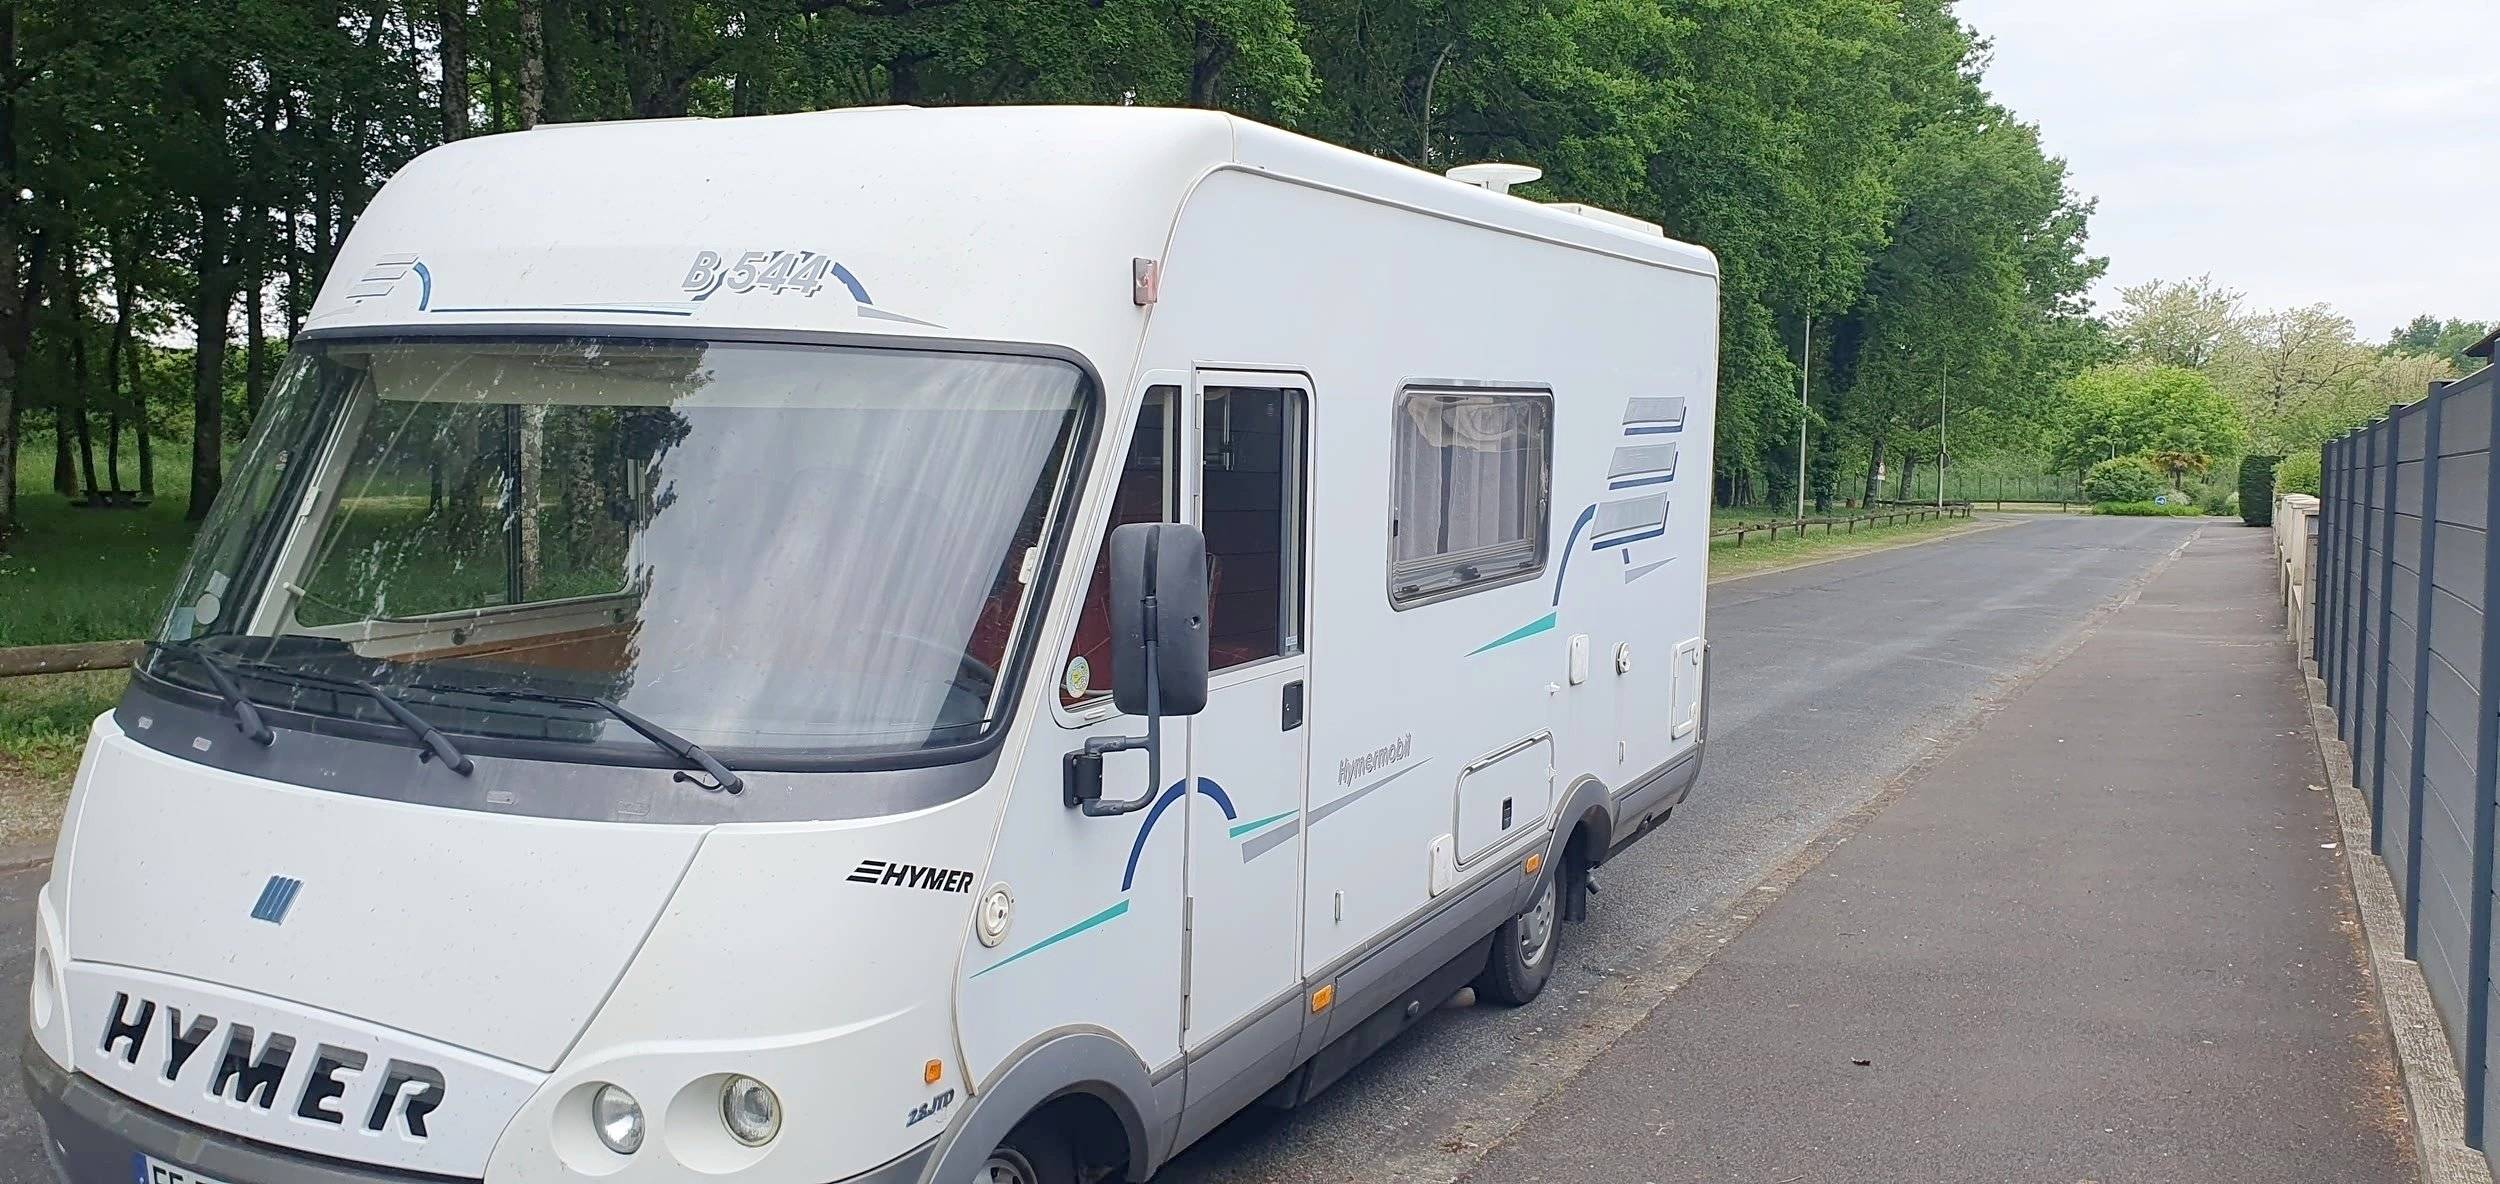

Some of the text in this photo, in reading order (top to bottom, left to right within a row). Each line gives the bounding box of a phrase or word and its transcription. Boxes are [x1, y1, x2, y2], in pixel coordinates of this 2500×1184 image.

[682, 251, 830, 297] B 544
[1338, 732, 1411, 787] Hymermobil
[881, 863, 974, 893] HYMER
[98, 991, 446, 1142] HYMER
